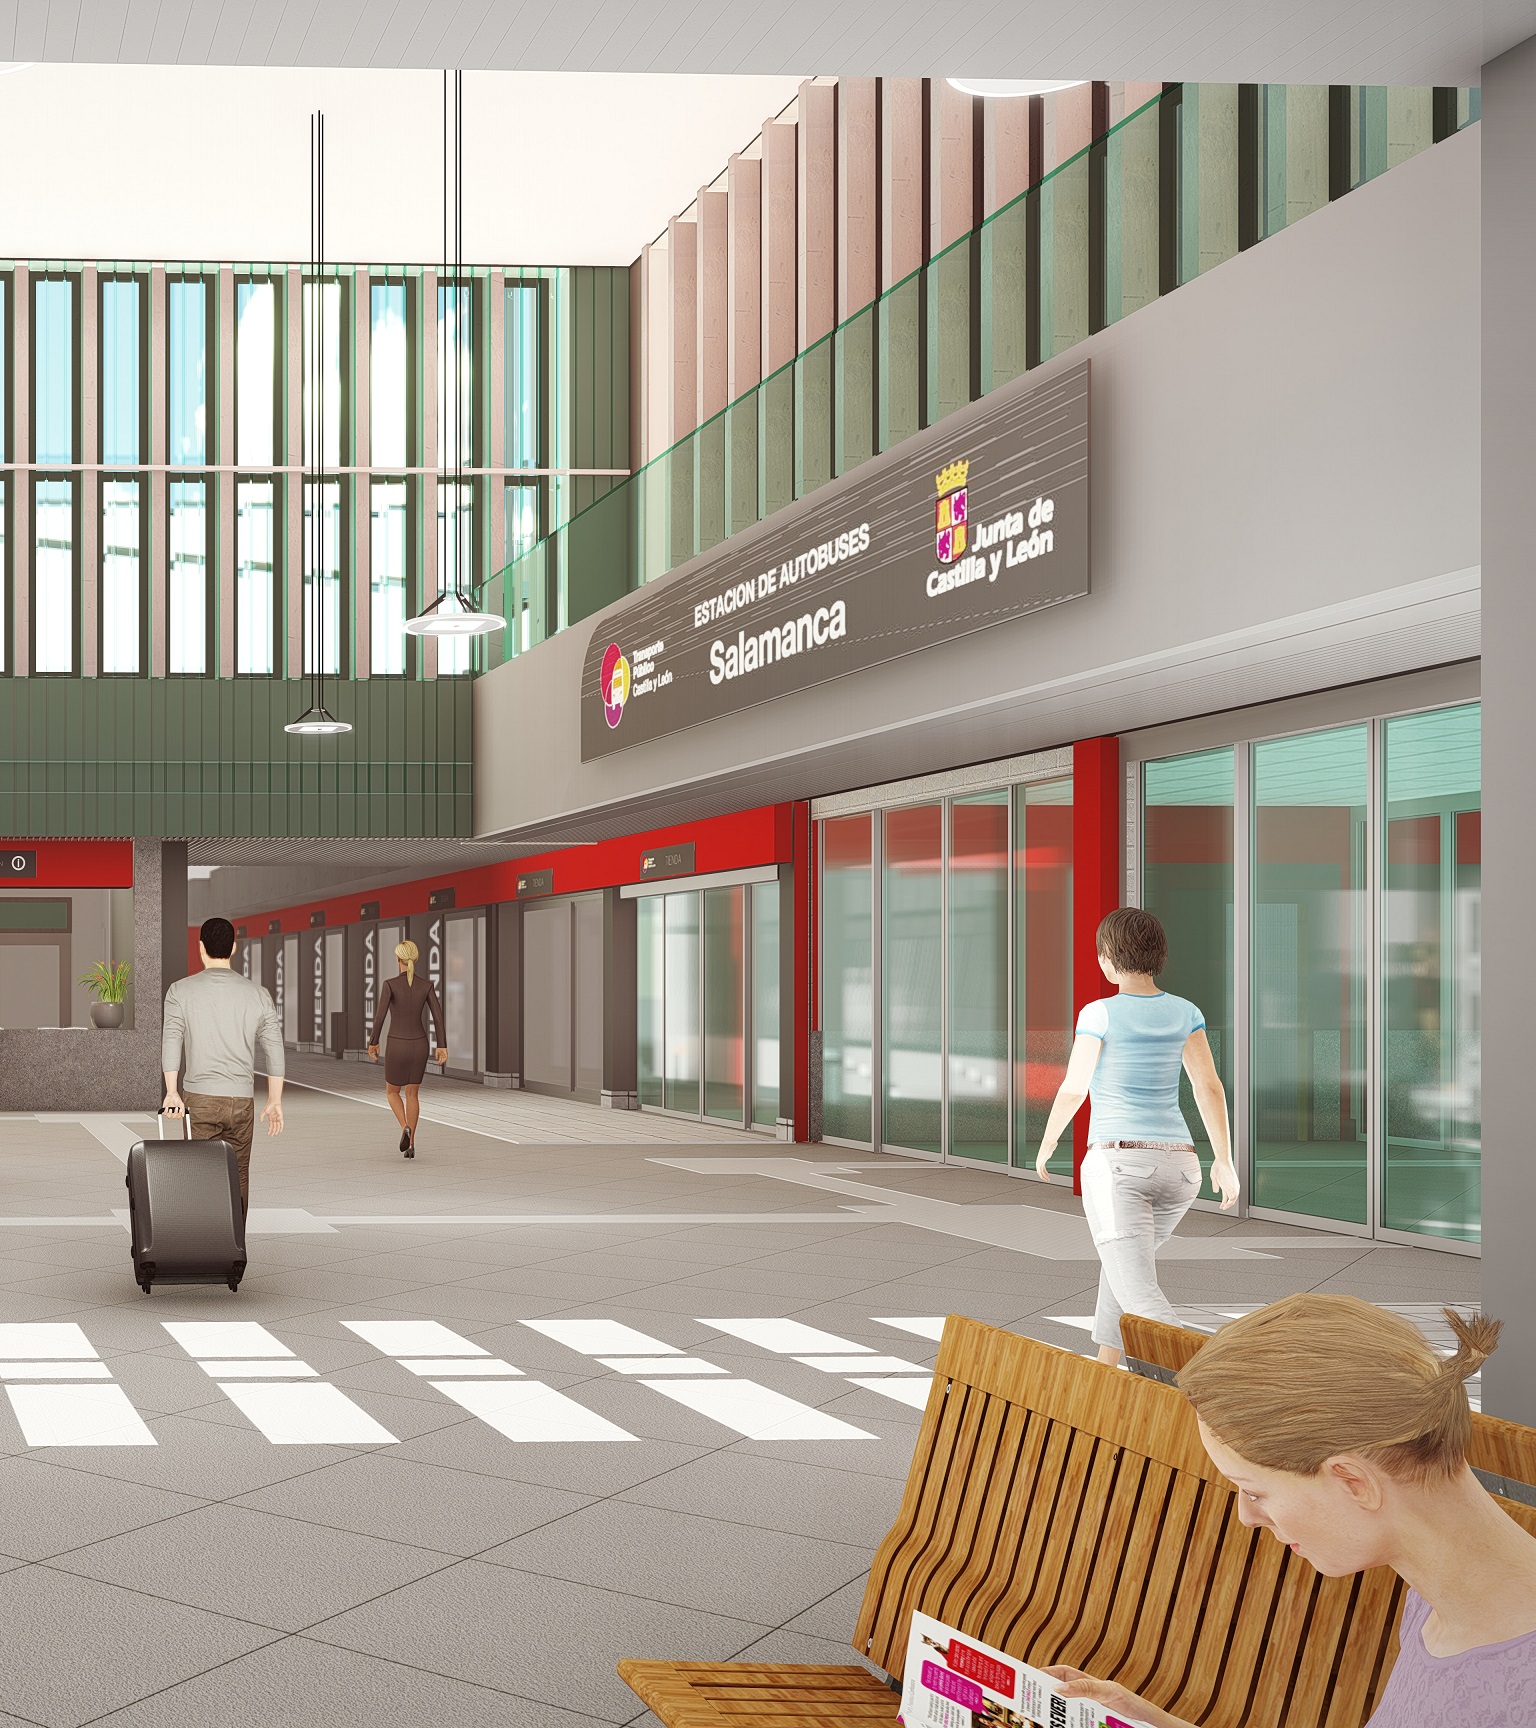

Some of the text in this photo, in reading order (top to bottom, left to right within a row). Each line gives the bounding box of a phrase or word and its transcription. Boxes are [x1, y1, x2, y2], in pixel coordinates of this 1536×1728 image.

[972, 497, 1055, 552] Junta de
[694, 523, 870, 628] ESTACION DE AUTOBUSES
[926, 529, 1054, 597] Castilla y León
[633, 640, 664, 664] Transporte
[709, 600, 847, 685] Salamanca
[633, 669, 673, 697] Castilla y León
[665, 854, 682, 866] TIENDA
[314, 936, 322, 1042] TIENDA
[429, 919, 440, 1056] TINDA
[1050, 1694, 1066, 1725] EVER!
